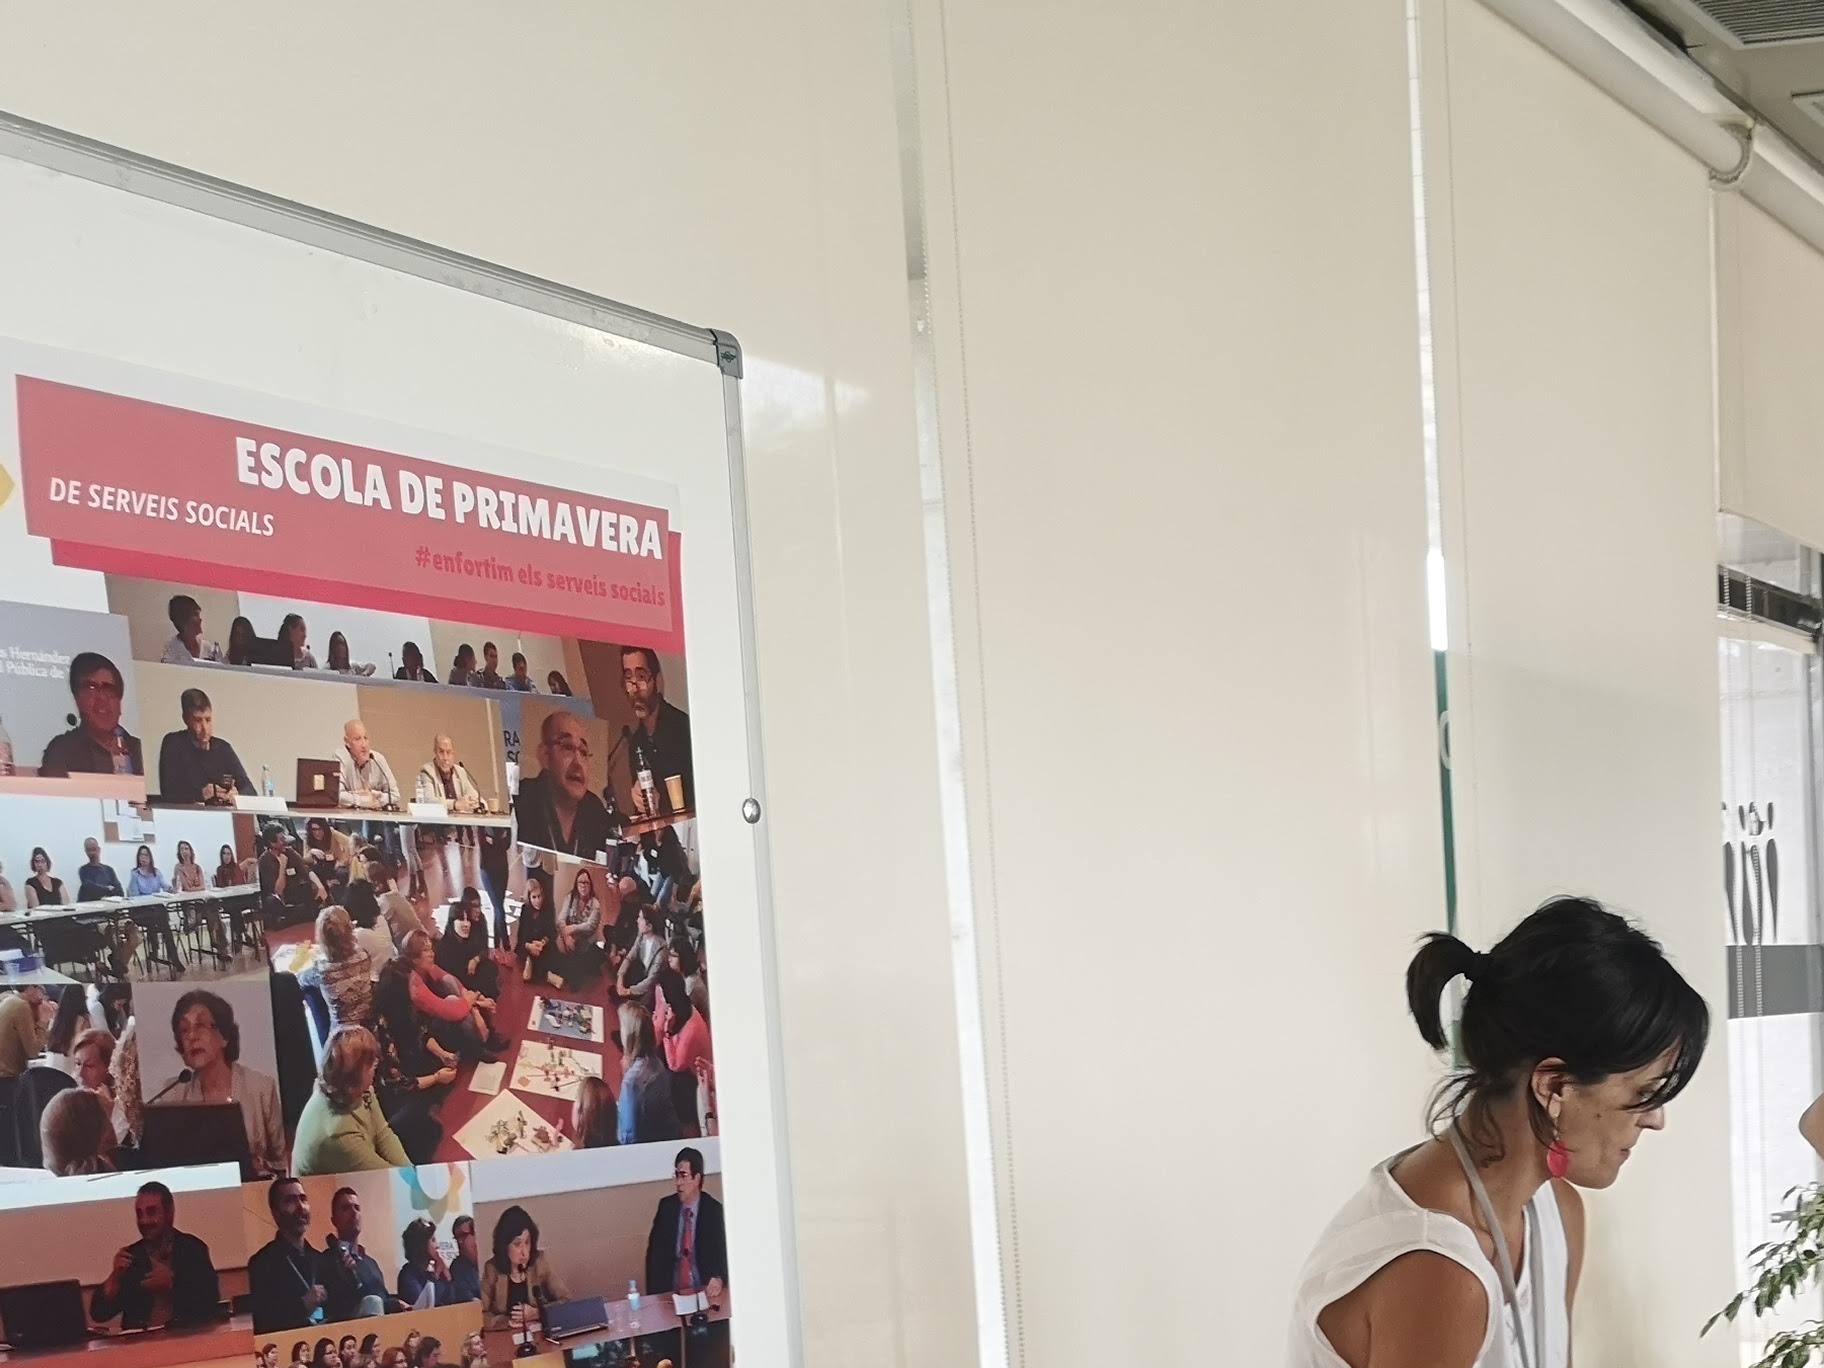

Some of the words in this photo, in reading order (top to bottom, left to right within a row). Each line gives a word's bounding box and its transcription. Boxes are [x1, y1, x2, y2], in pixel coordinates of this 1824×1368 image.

[50, 477, 82, 505] DE
[88, 484, 179, 521] SERVEIS
[185, 500, 275, 536] SOCIALS
[236, 436, 392, 510] ESCOLA
[399, 469, 447, 520] DE
[453, 481, 663, 560] PRIMAVERA
[415, 546, 514, 583] #enfortim
[518, 564, 543, 587] els
[547, 571, 607, 598] serveis
[611, 582, 666, 607] socials
